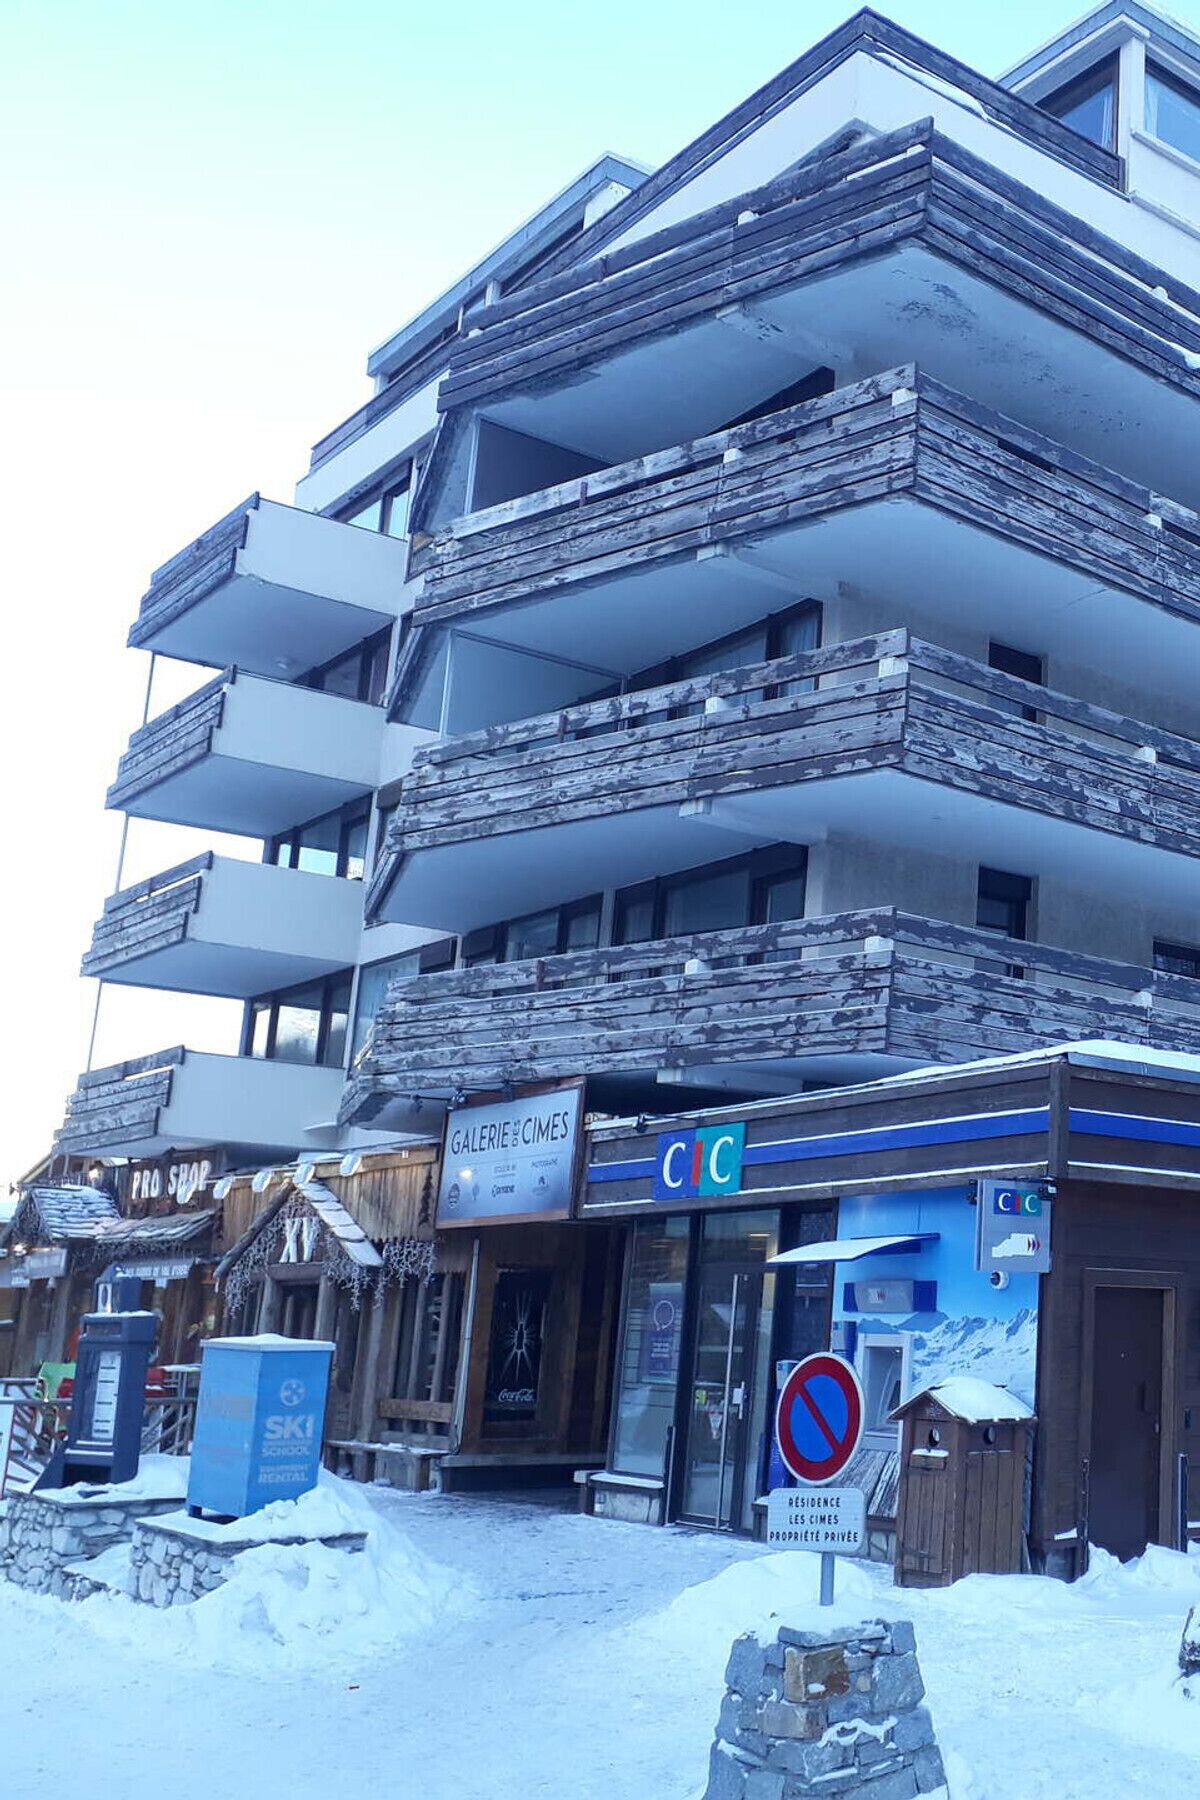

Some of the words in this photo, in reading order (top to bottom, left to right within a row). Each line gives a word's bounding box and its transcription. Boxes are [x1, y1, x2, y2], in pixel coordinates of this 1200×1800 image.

[451, 1121, 511, 1155] GALERIE
[512, 1119, 520, 1147] DES
[522, 1111, 569, 1144] CIMES
[662, 1135, 735, 1189] CIC
[131, 1168, 160, 1200] PRO
[167, 1160, 212, 1195] SHOP
[998, 1192, 1038, 1213] CIC
[263, 1415, 315, 1440] SKI
[262, 1447, 309, 1457] SCHOOL
[259, 1472, 308, 1482] RENTAL
[788, 1496, 841, 1508] RÉSIDENCE
[788, 1514, 805, 1525] LES
[808, 1514, 839, 1525] CIMES
[769, 1530, 820, 1543] PROPRIÉTÉ
[824, 1530, 859, 1543] PRIVÉE
